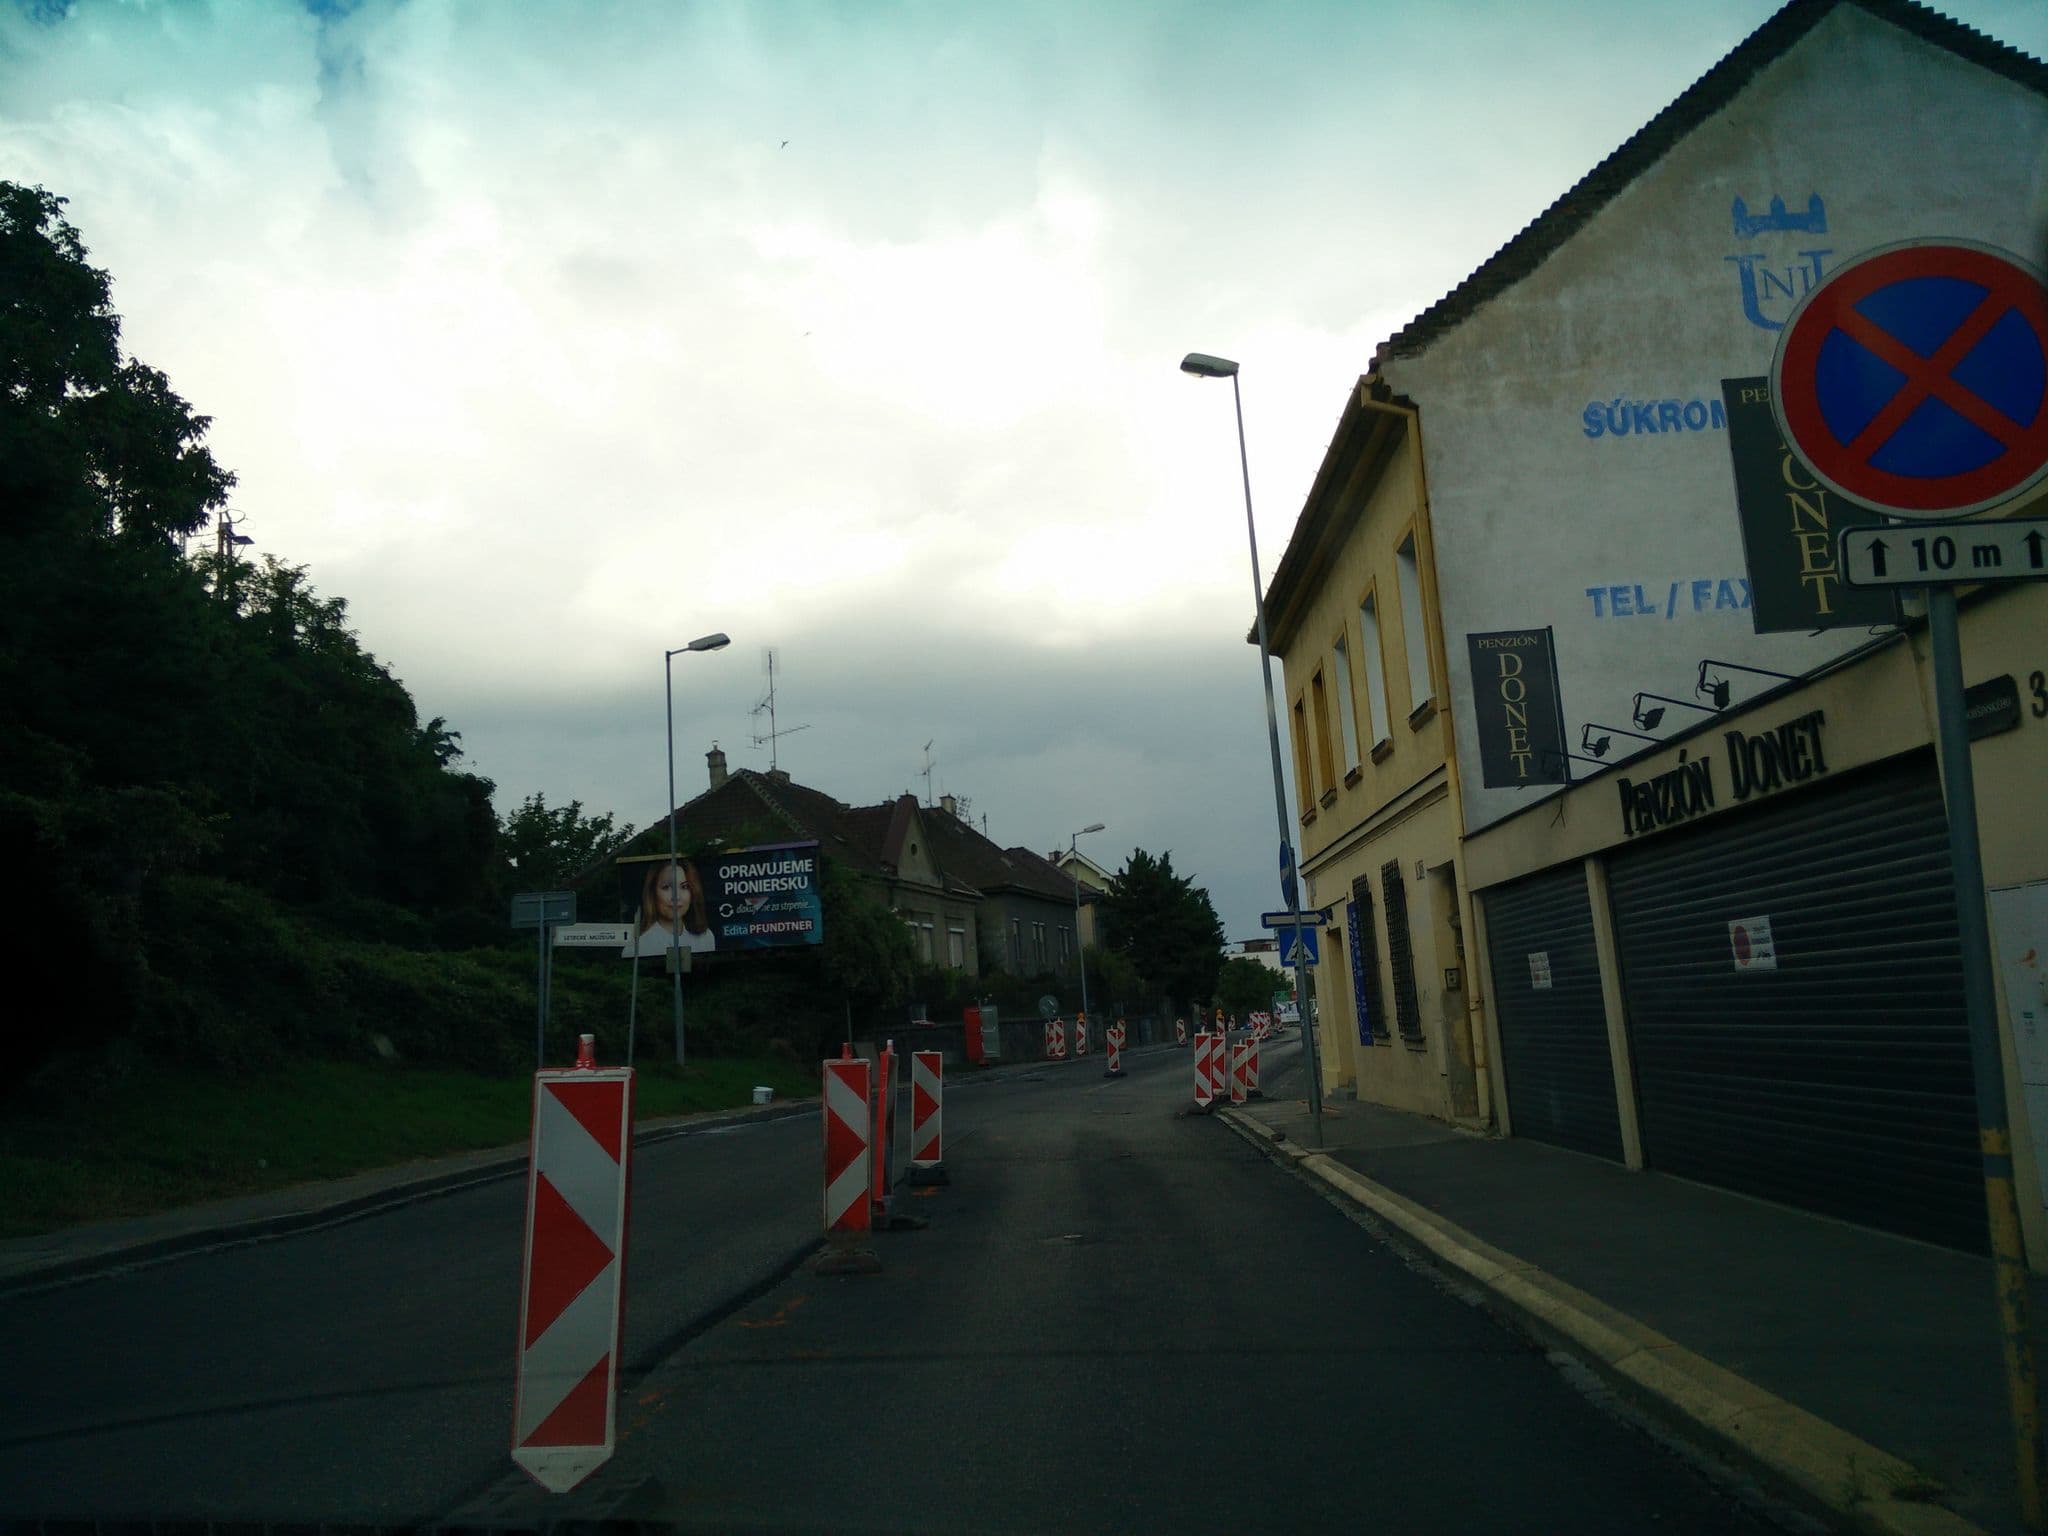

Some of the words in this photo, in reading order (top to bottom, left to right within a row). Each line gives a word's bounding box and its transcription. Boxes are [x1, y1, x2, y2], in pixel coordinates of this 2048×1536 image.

[1912, 535, 1956, 572] 10
[1973, 544, 2002, 568] m
[1586, 582, 1656, 618] TEL
[1477, 633, 1538, 649] PENZIÓN
[1496, 652, 1533, 778] DONET
[1617, 748, 1715, 836] PENZIÓN
[1724, 709, 1830, 799] DONET
[719, 858, 813, 879] OPRAVUJEME
[724, 876, 808, 895] PIONIERSKU
[723, 925, 749, 936] Edita
[749, 920, 813, 935] PFUNDTNER
